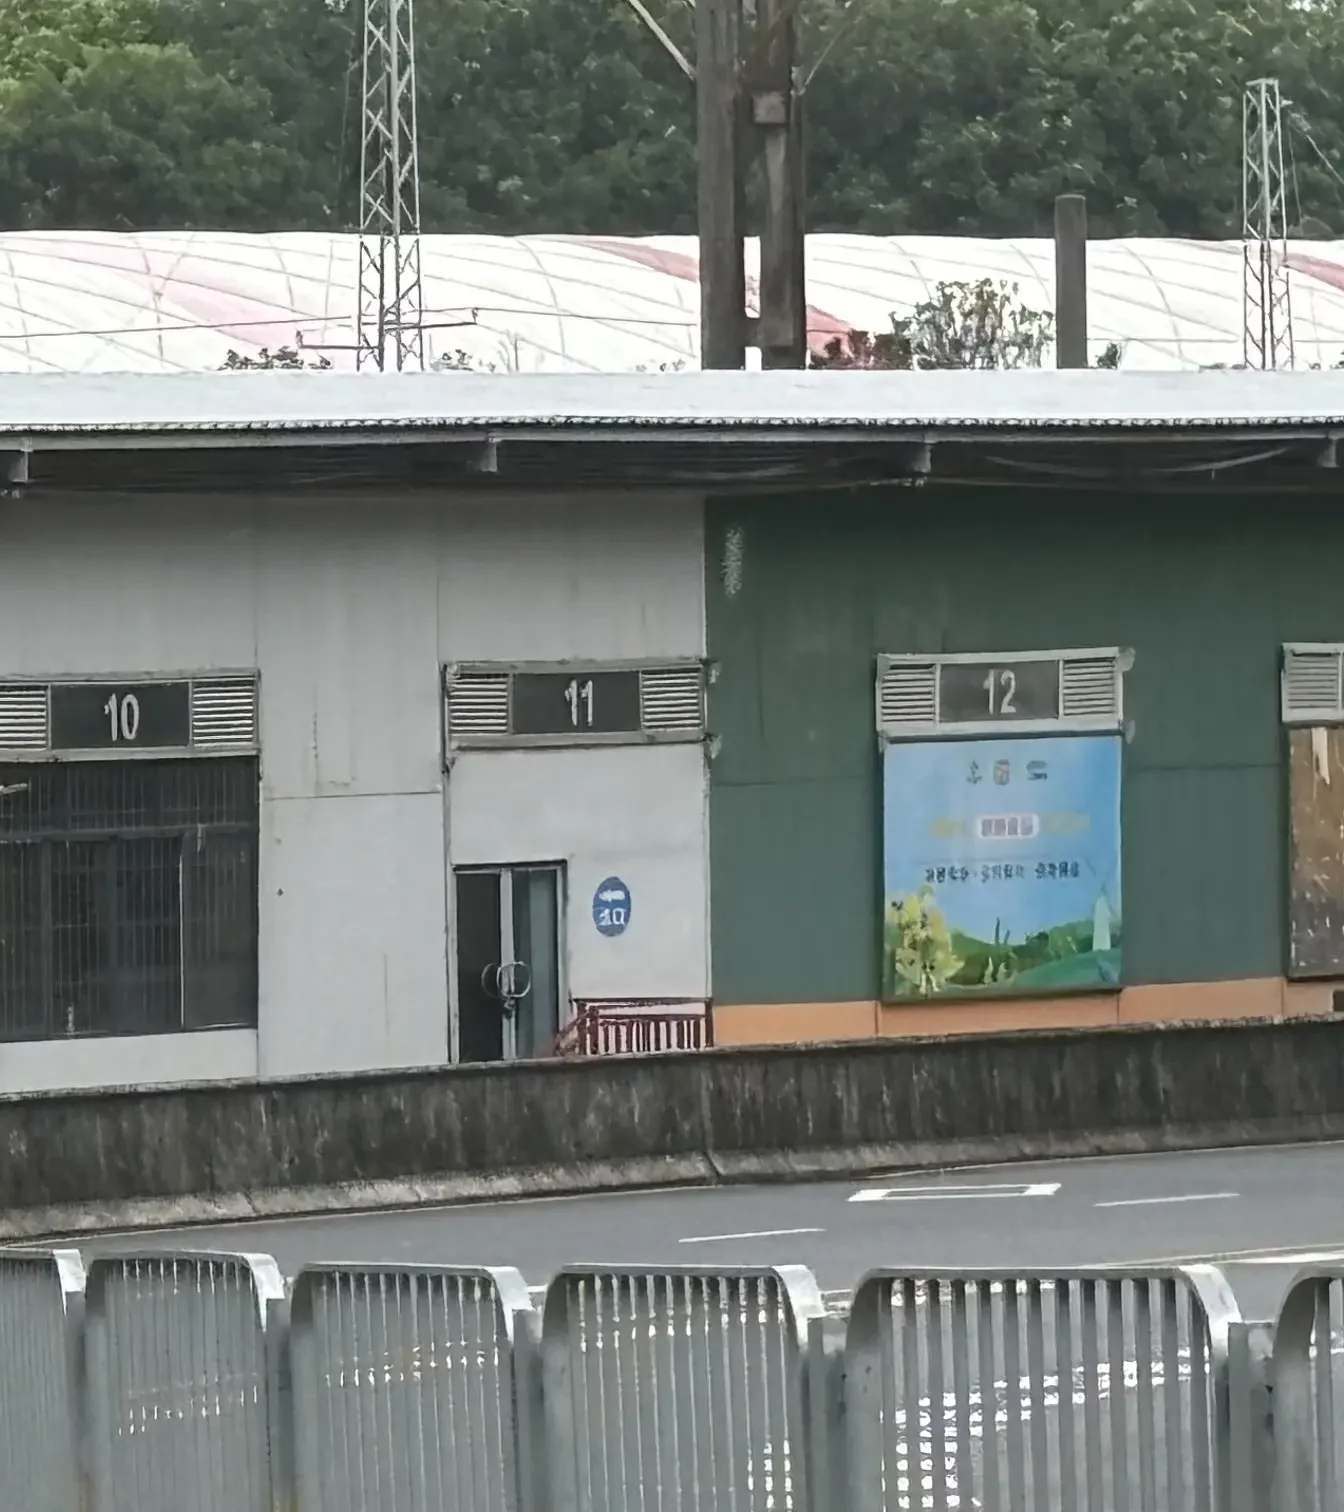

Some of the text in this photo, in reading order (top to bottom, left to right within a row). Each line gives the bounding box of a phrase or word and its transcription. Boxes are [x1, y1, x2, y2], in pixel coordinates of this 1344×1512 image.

[564, 679, 593, 726] 11
[983, 669, 1016, 714] 12
[104, 693, 140, 741] 10
